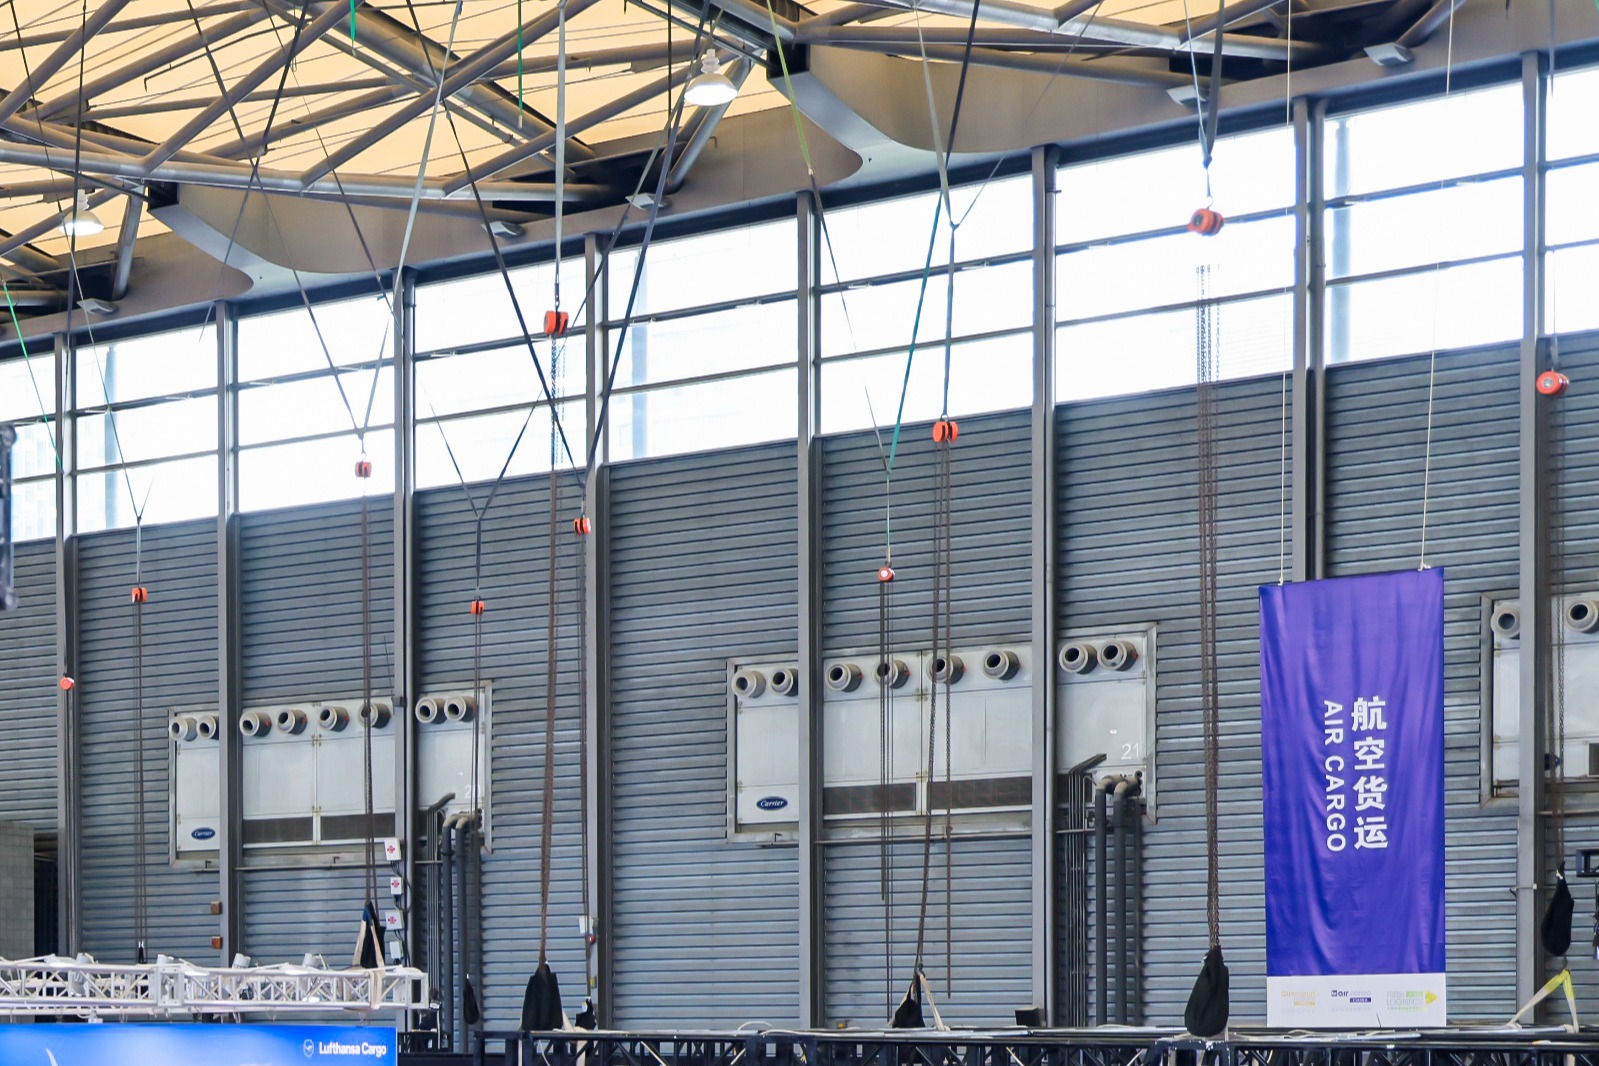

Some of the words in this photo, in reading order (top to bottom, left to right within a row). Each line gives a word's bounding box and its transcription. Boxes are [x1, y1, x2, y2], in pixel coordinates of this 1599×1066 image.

[1323, 699, 1344, 746] AIR
[1120, 742, 1139, 760] 21
[1351, 695, 1389, 850] 航空货运
[760, 799, 785, 808] Carrier
[1324, 755, 1346, 852] CARGO
[319, 1041, 361, 1055] Lufthansa
[361, 1041, 387, 1058] Cargo
